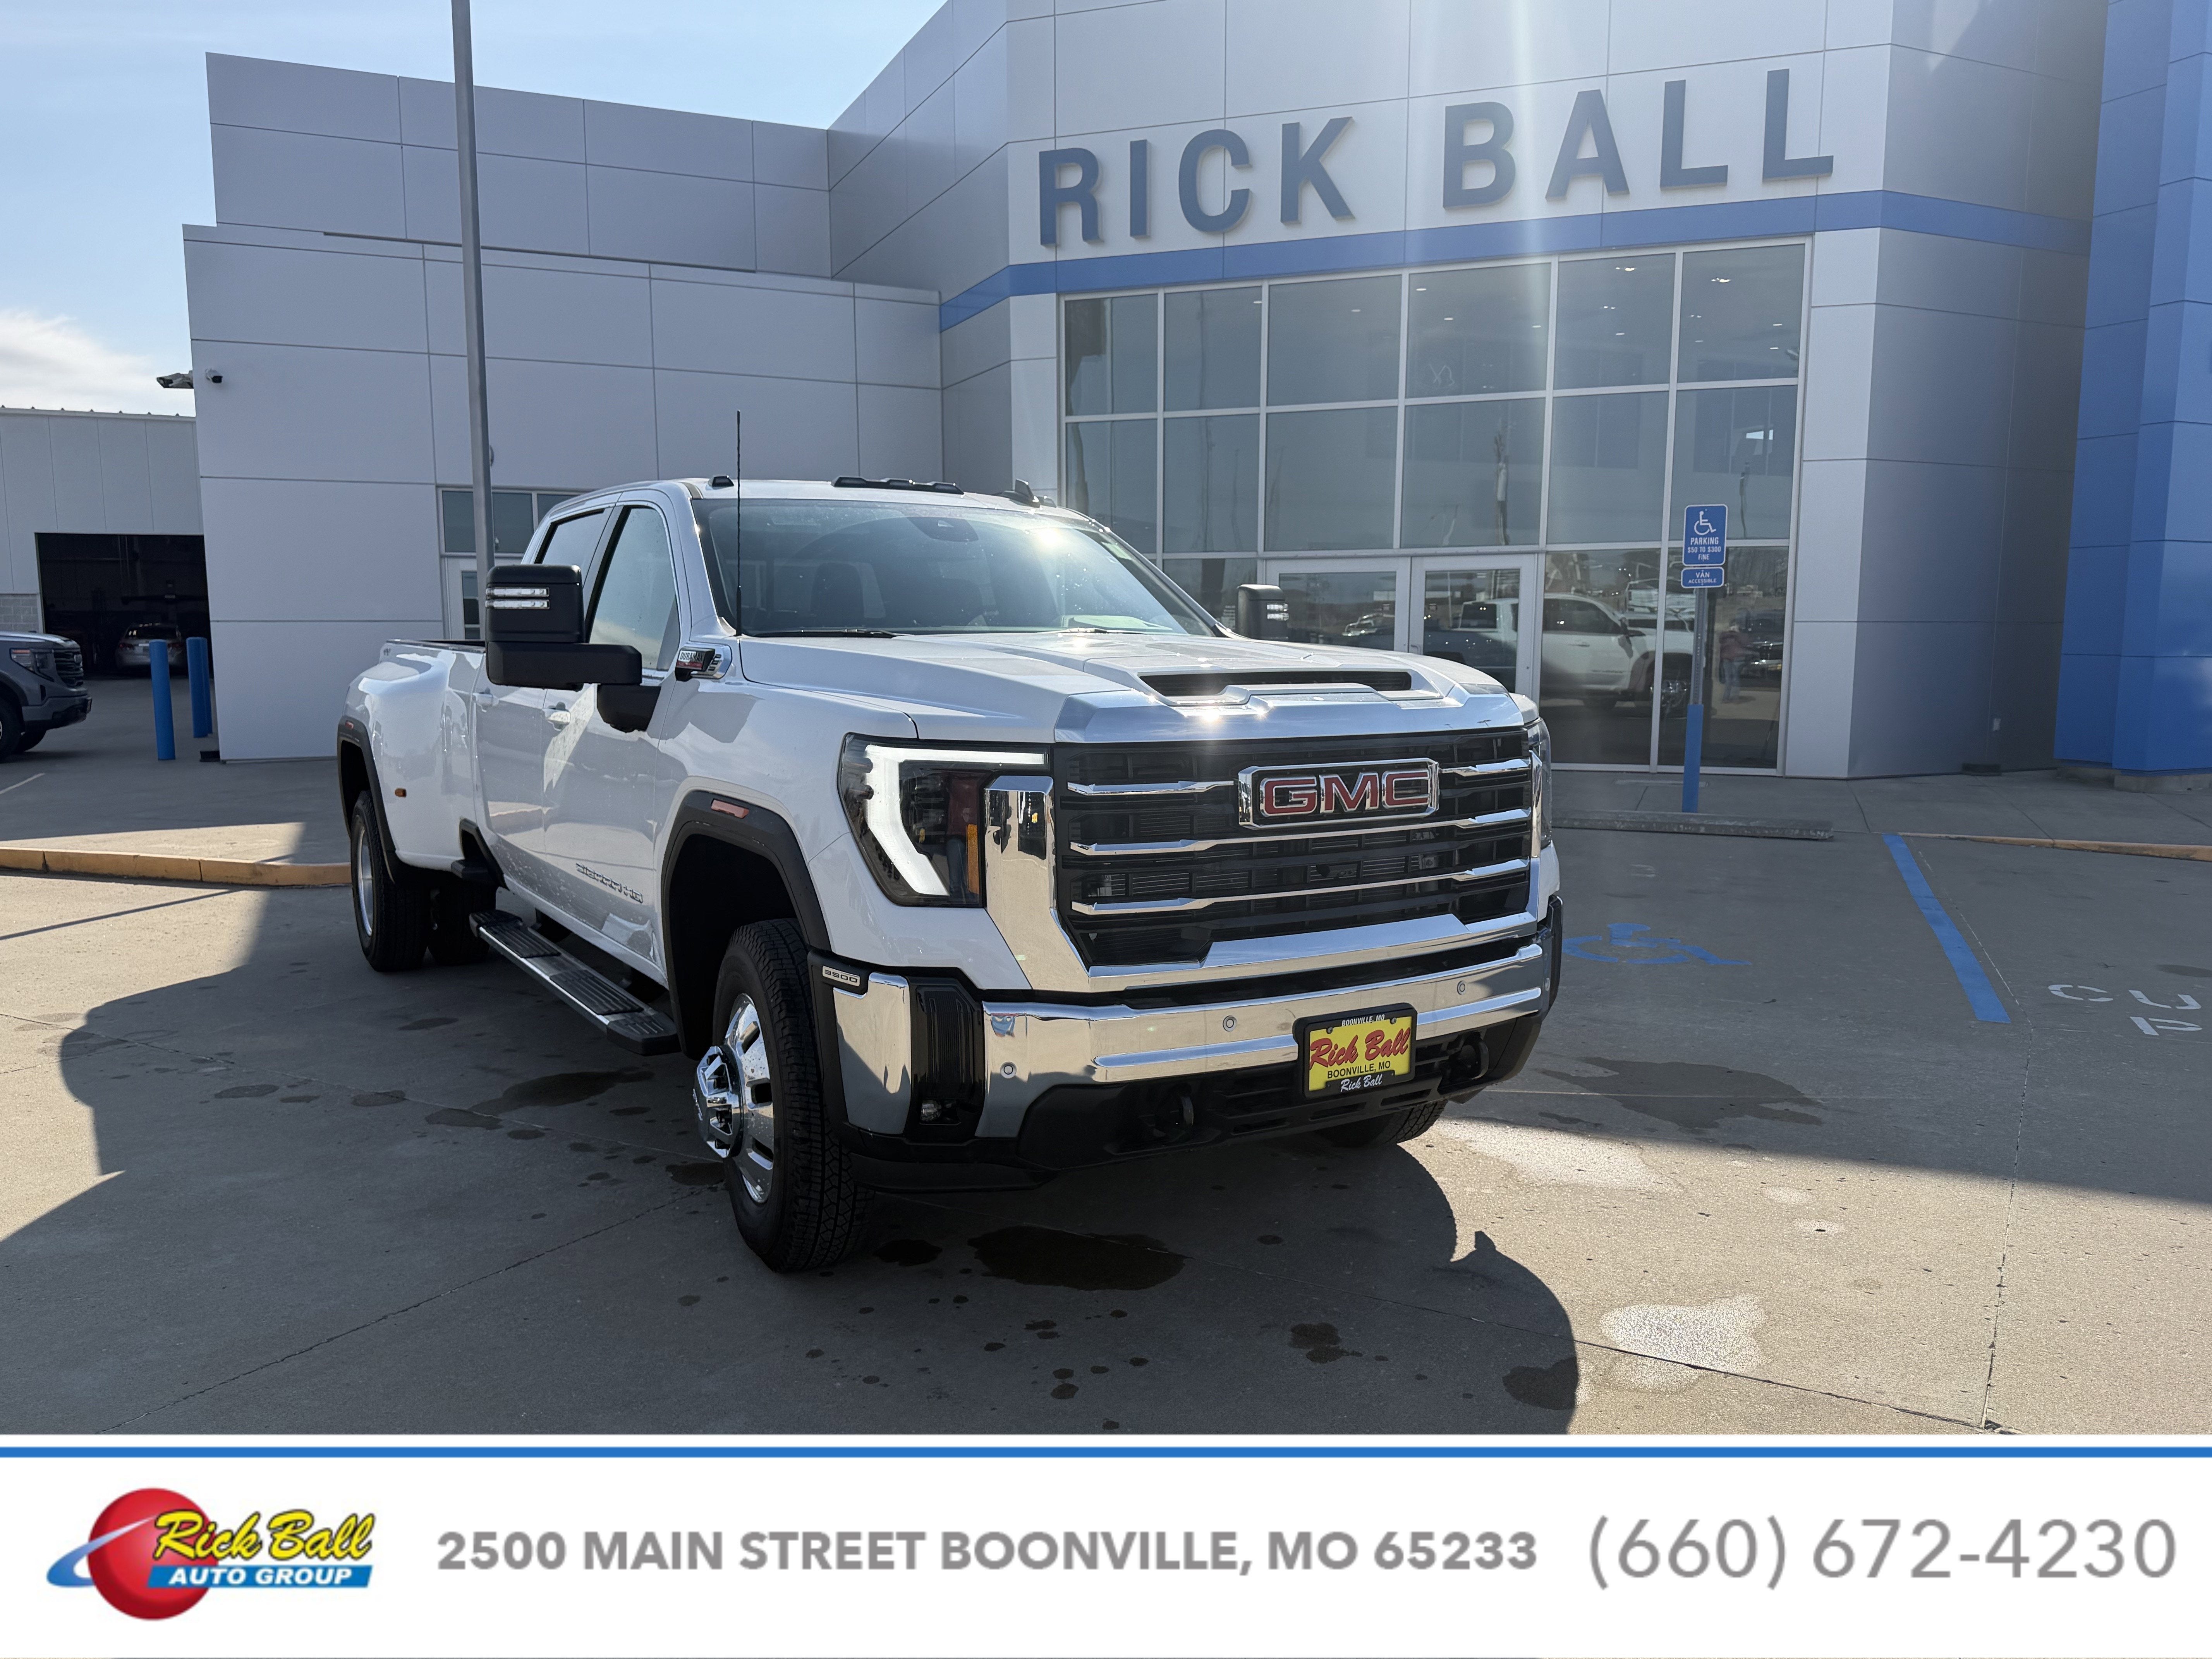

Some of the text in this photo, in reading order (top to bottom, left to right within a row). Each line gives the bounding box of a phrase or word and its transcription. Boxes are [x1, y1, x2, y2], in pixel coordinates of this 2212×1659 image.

[1039, 68, 1834, 247] RICK BALL
[1690, 537, 1719, 545] PARKING
[680, 652, 703, 662] DURAMAX
[1259, 768, 1430, 817] GMC
[824, 969, 857, 983] 3500
[1341, 1015, 1374, 1027] BOONVILLE,
[1309, 1027, 1411, 1070] Rick Ball
[1327, 1060, 1391, 1079] BOONVILLE, MO
[1340, 1074, 1382, 1092] Rick Ball
